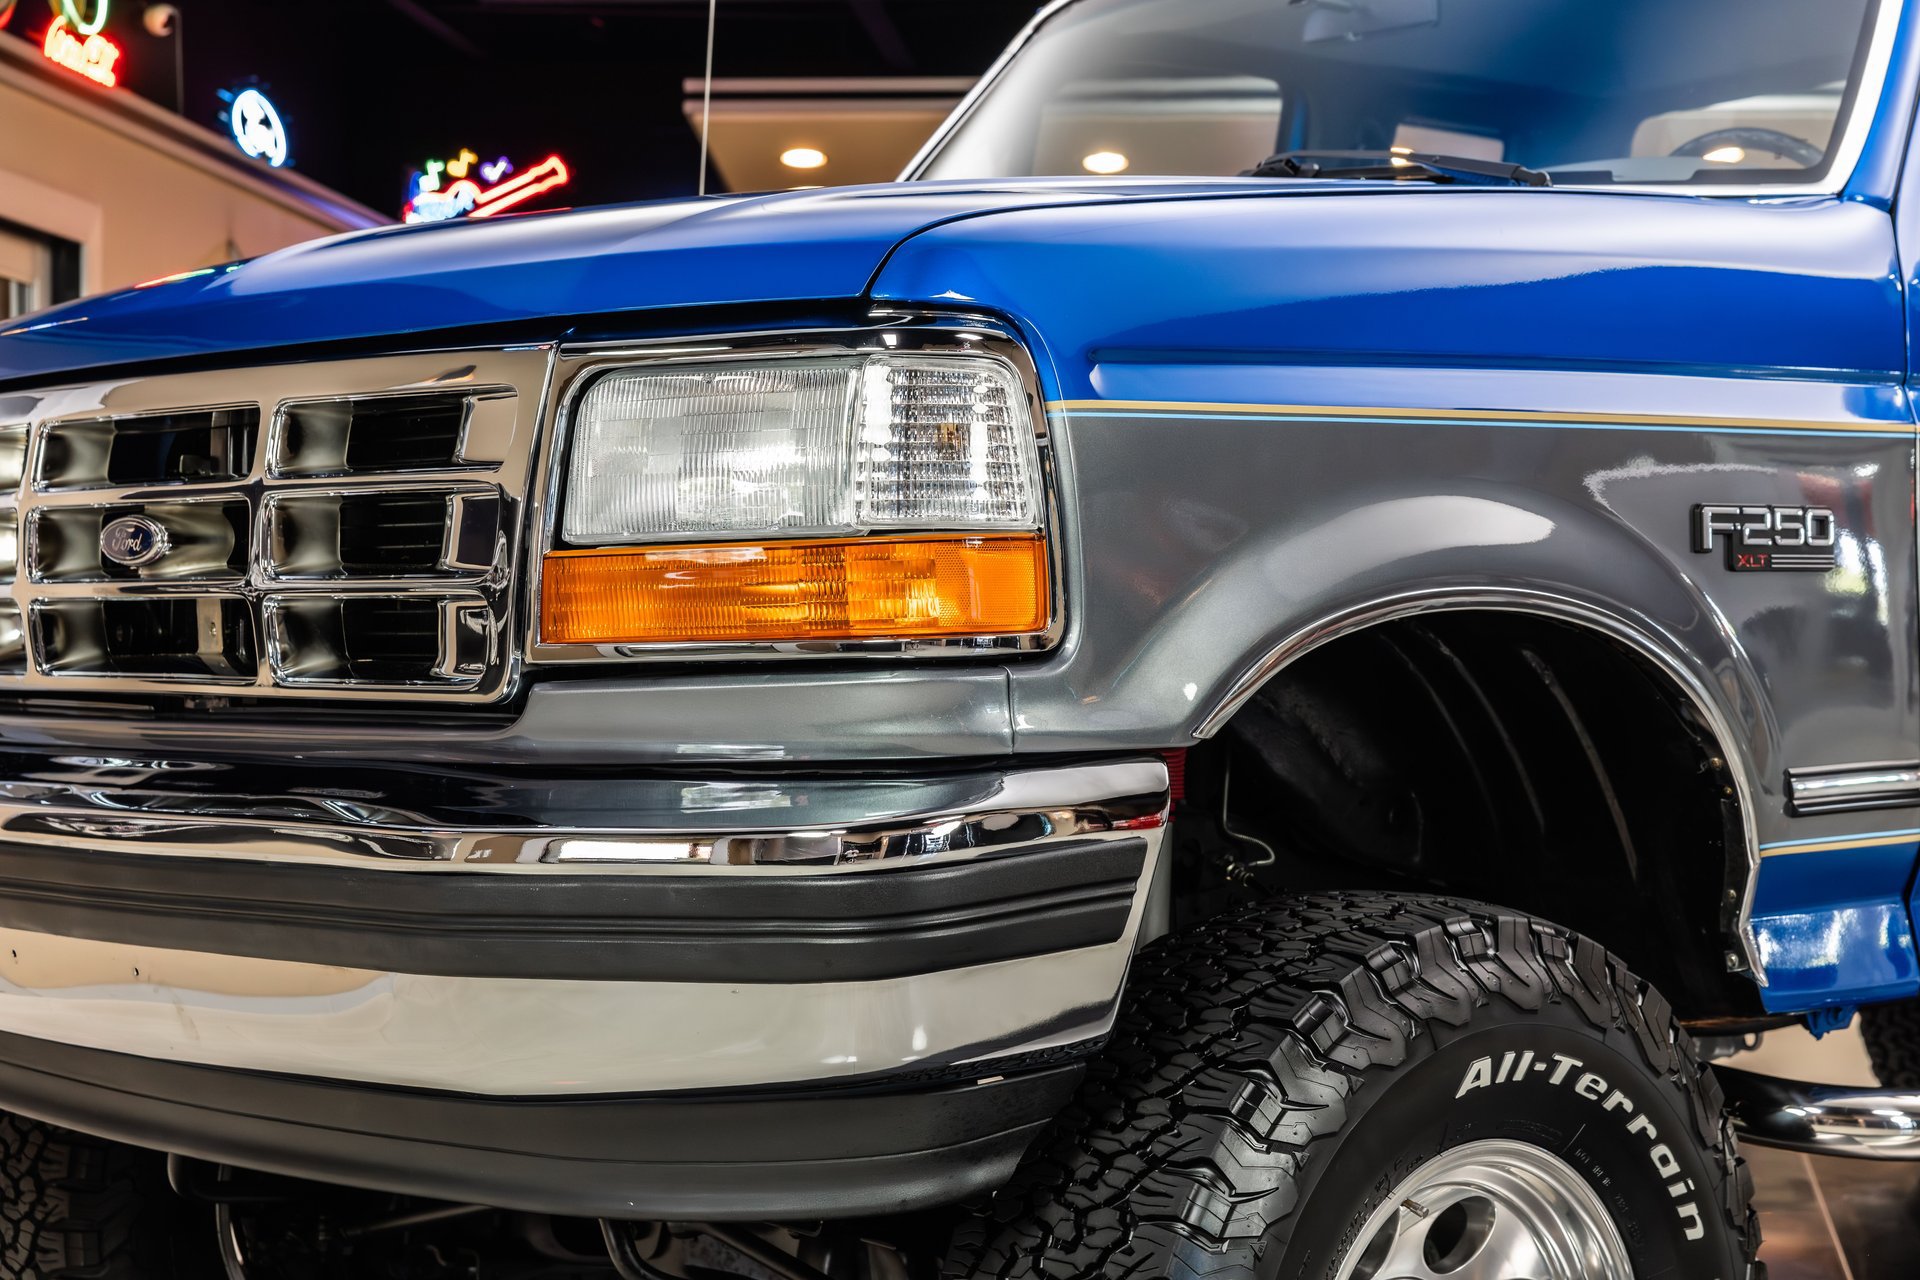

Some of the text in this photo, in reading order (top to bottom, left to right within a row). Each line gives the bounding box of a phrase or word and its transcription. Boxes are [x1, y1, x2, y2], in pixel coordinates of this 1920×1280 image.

[111, 526, 143, 552] Ford
[1736, 553, 1769, 568] XLT
[1454, 1050, 1705, 1242] All-Terrain
